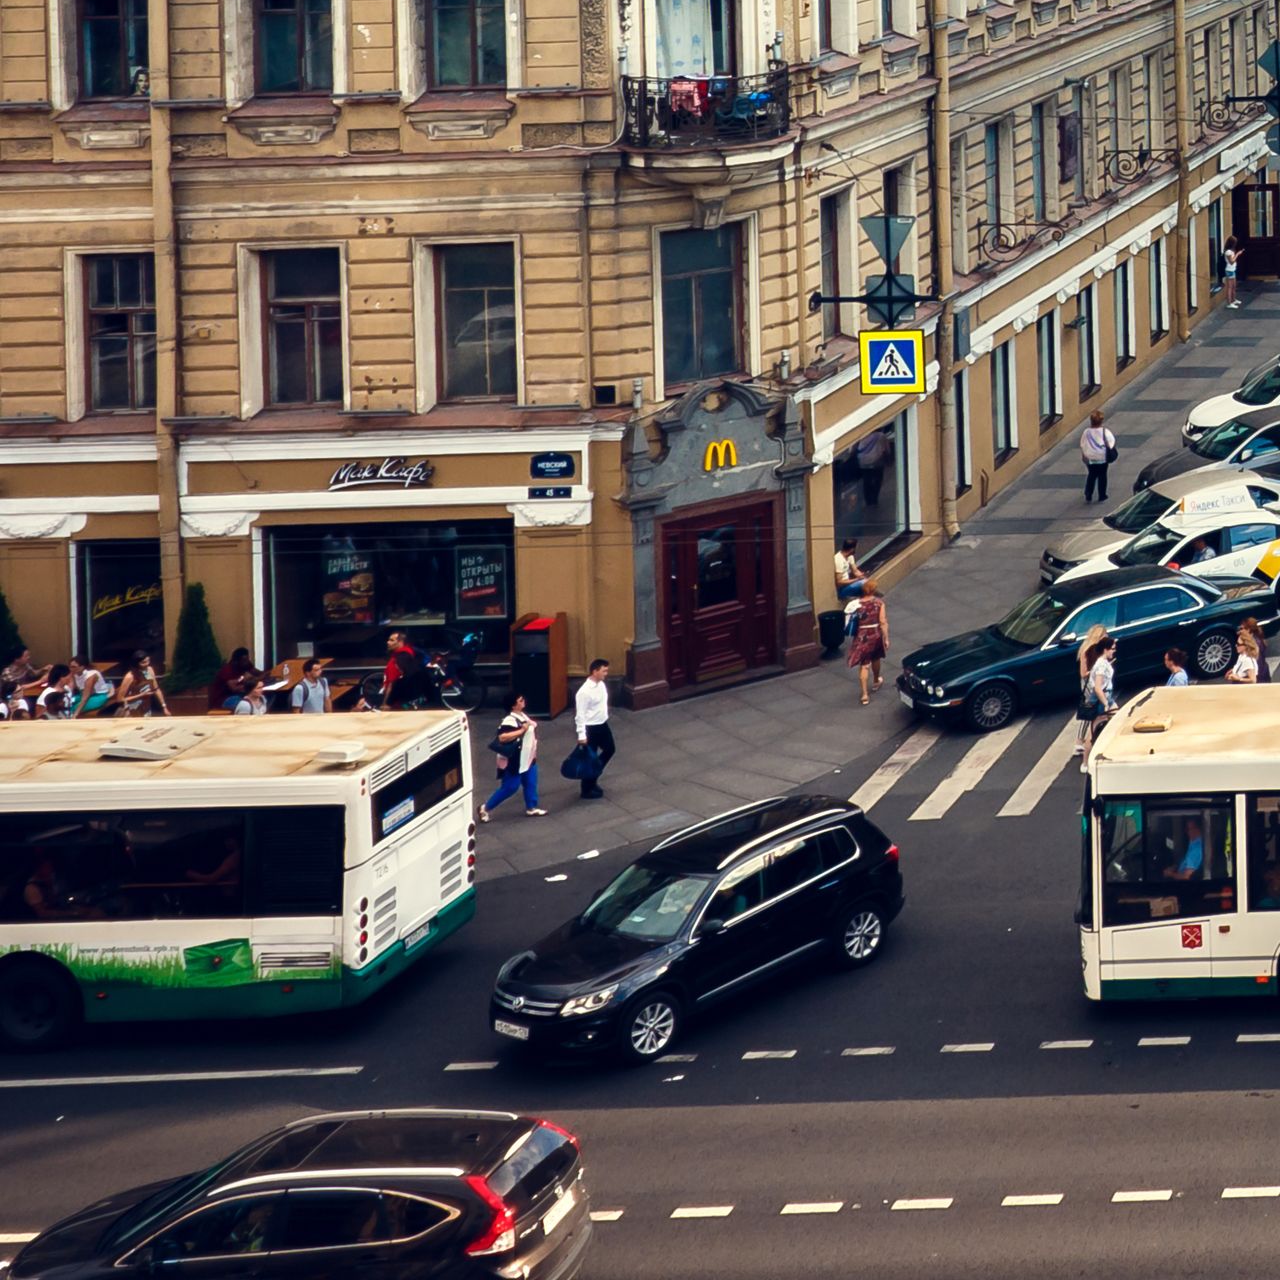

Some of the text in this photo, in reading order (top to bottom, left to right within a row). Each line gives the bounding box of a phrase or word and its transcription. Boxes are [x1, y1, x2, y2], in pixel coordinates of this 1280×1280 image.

[329, 458, 432, 488] Мак Кафе
[1190, 494, 1247, 513] Яндекс Такси
[461, 556, 475, 566] МЫ
[461, 563, 502, 578] ОТКРЫТЫ
[462, 578, 474, 590] ДО
